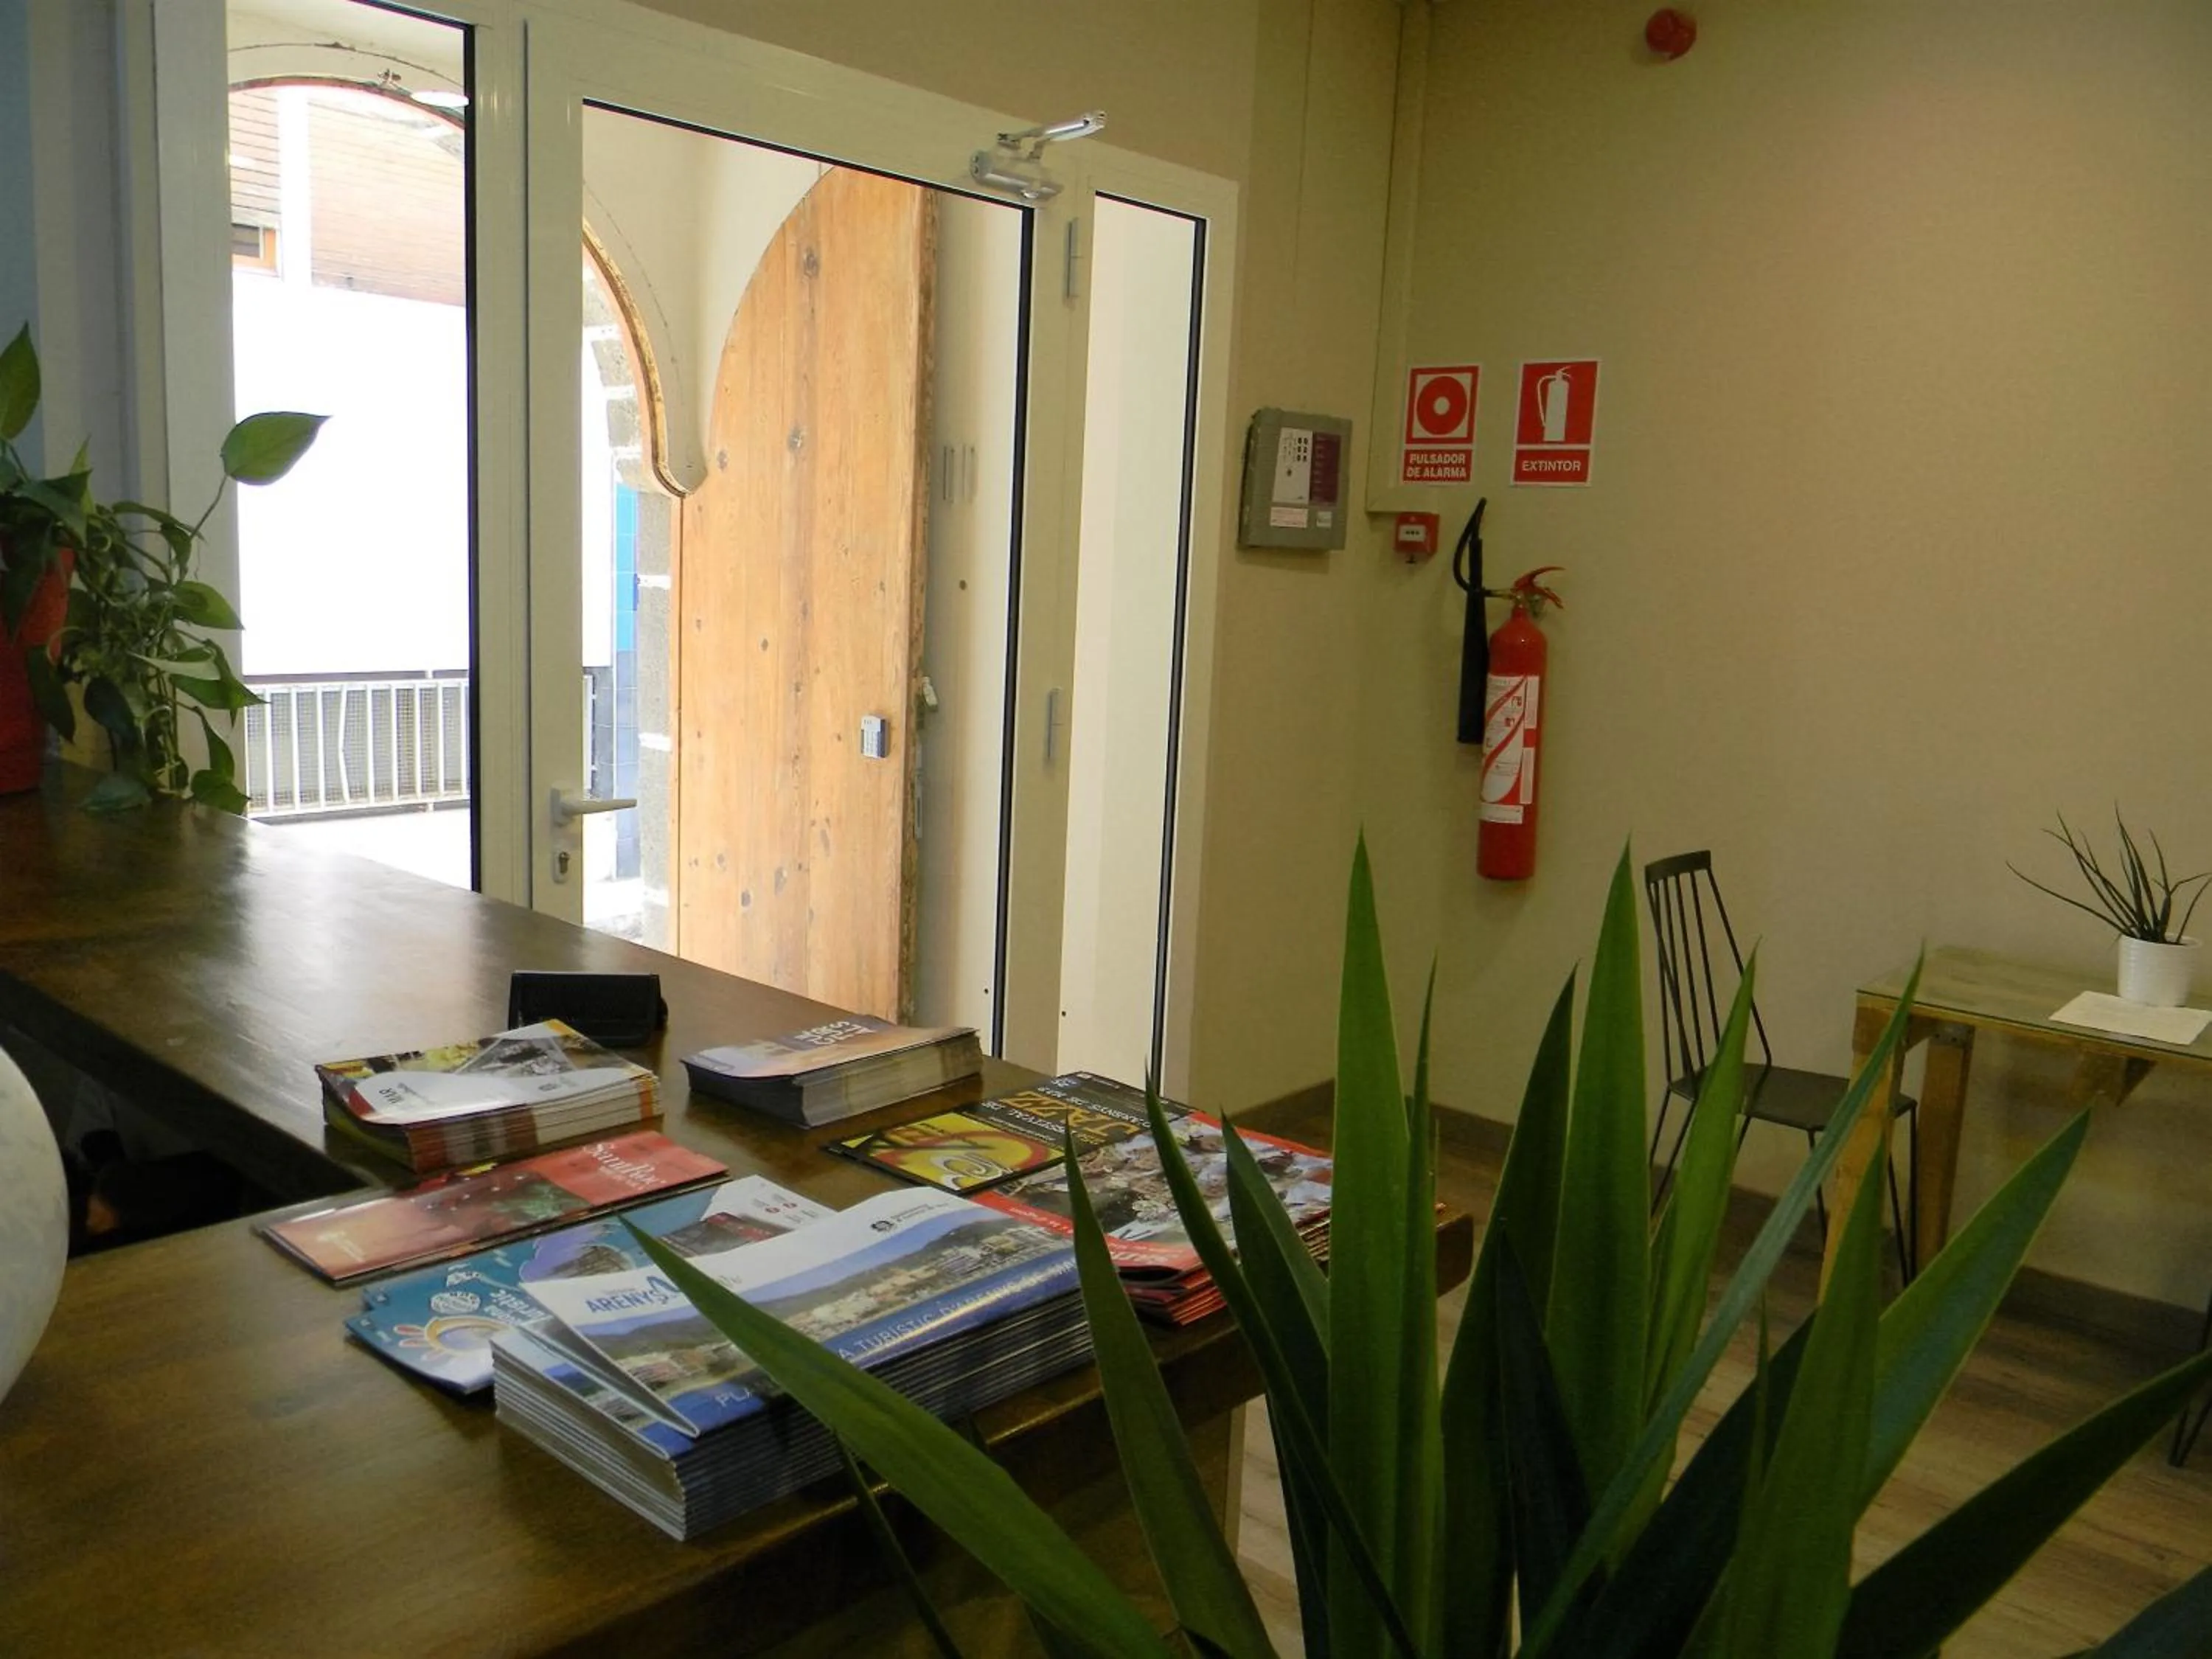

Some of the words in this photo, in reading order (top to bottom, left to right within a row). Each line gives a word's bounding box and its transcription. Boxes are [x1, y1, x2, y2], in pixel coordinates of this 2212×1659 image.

[1409, 453, 1466, 464] PULSADOR
[1522, 459, 1581, 471] EXTINTOR
[1406, 467, 1421, 477] DE
[1423, 467, 1467, 478] ALARMA
[999, 1091, 1140, 1135] JAZZ
